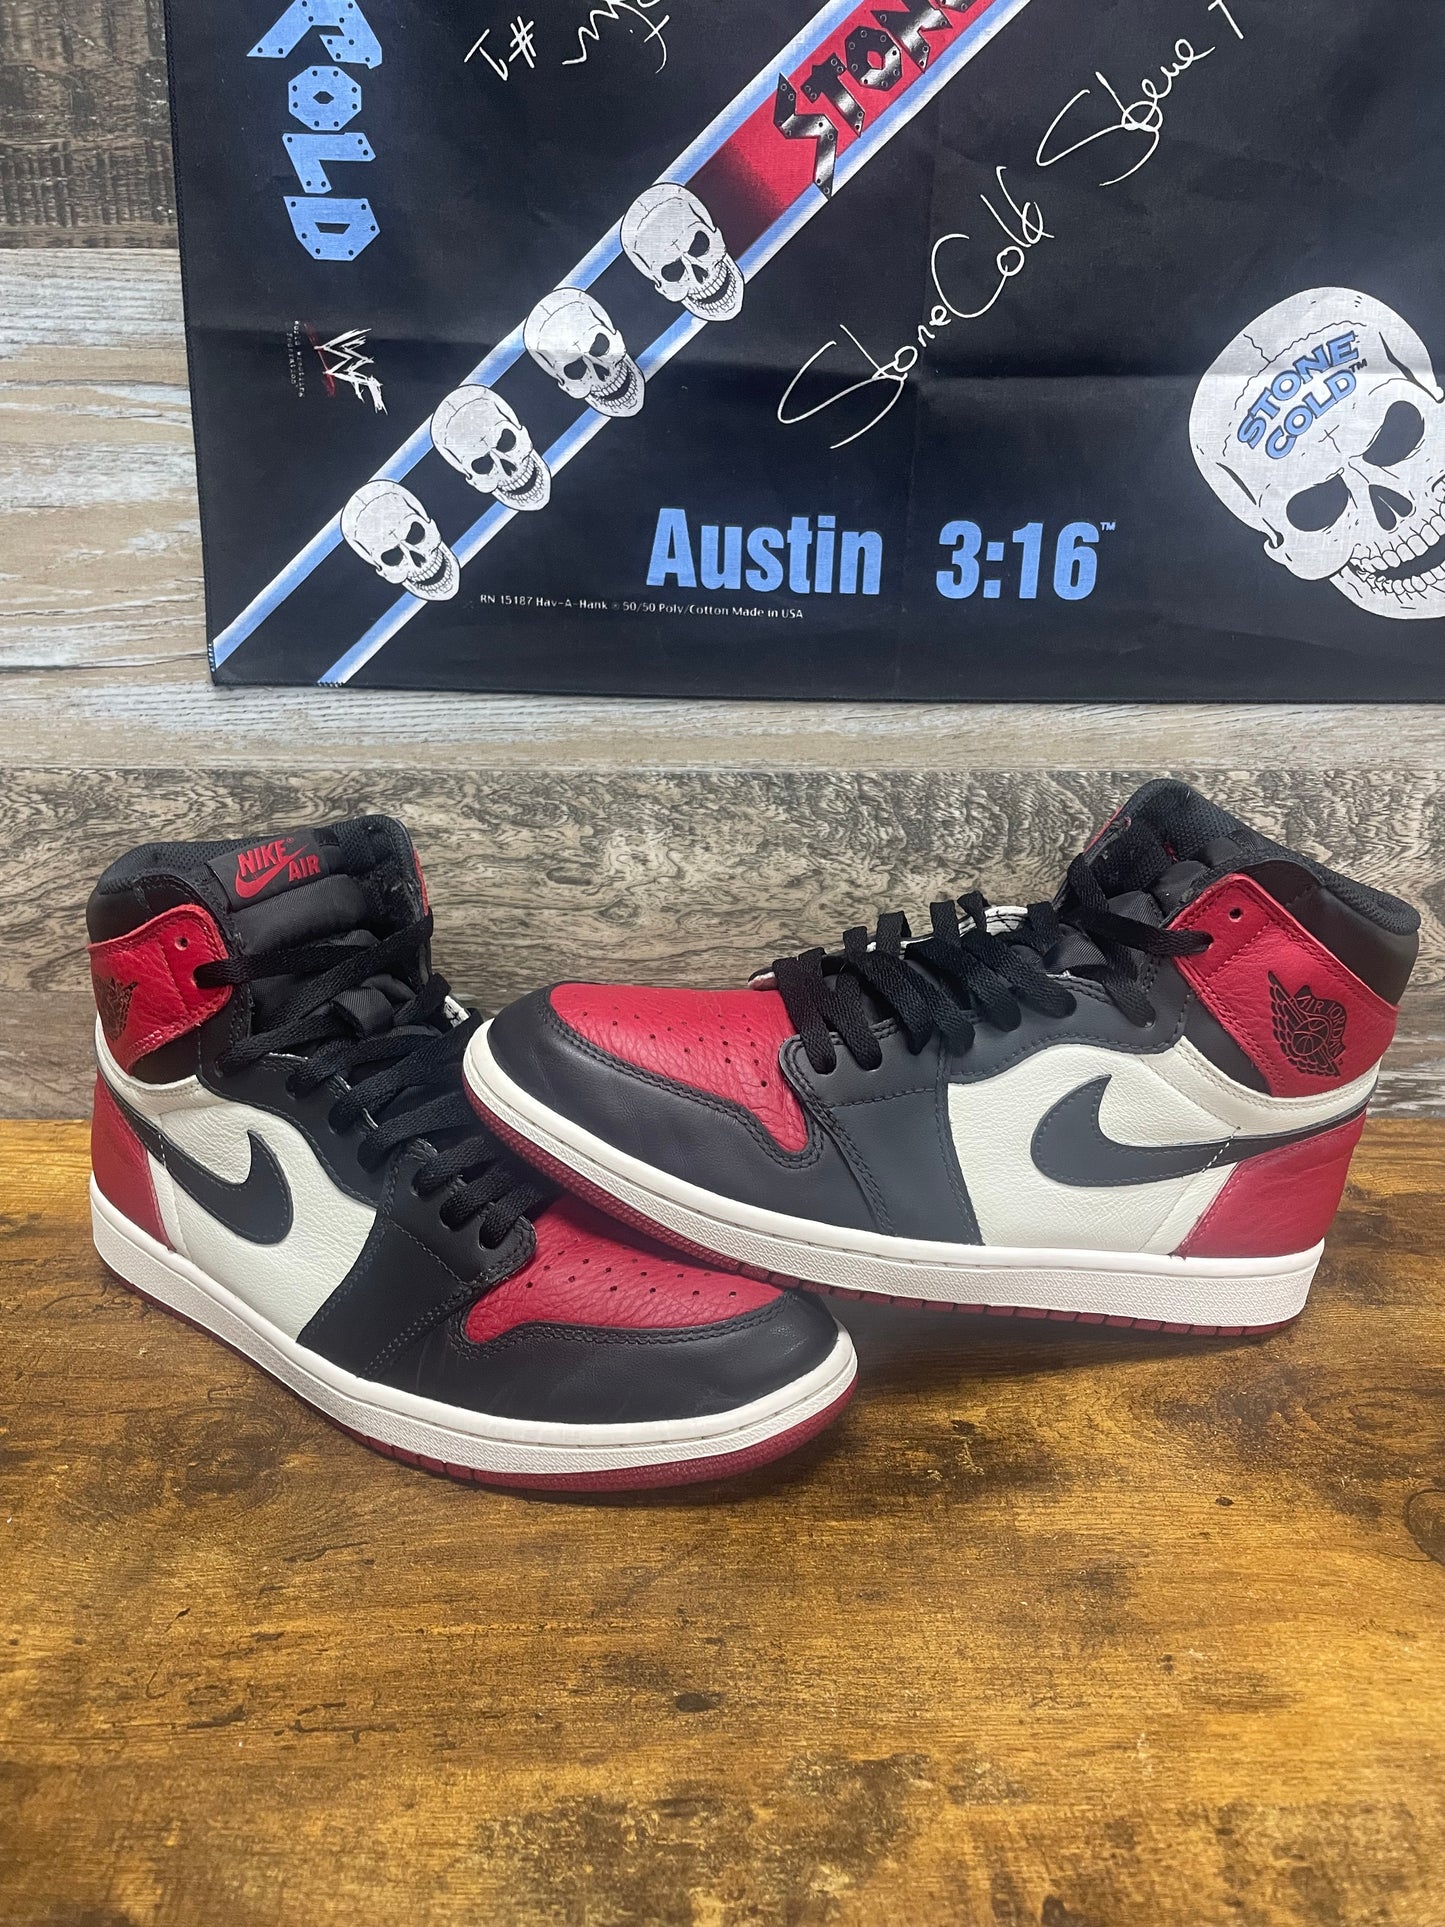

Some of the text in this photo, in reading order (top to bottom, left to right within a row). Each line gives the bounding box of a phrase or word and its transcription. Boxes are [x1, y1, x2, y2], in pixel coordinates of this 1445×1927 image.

[773, 0, 980, 201] STON
[1237, 330, 1359, 449] STONE
[646, 508, 883, 595] Austin
[480, 594, 496, 604] RN
[500, 595, 533, 606] 15187
[622, 601, 656, 613] 50/50
[732, 606, 765, 617] Made
[767, 607, 779, 618] in
[781, 608, 804, 619] USA
[237, 839, 290, 877] NIKE
[288, 854, 320, 882] AIR
